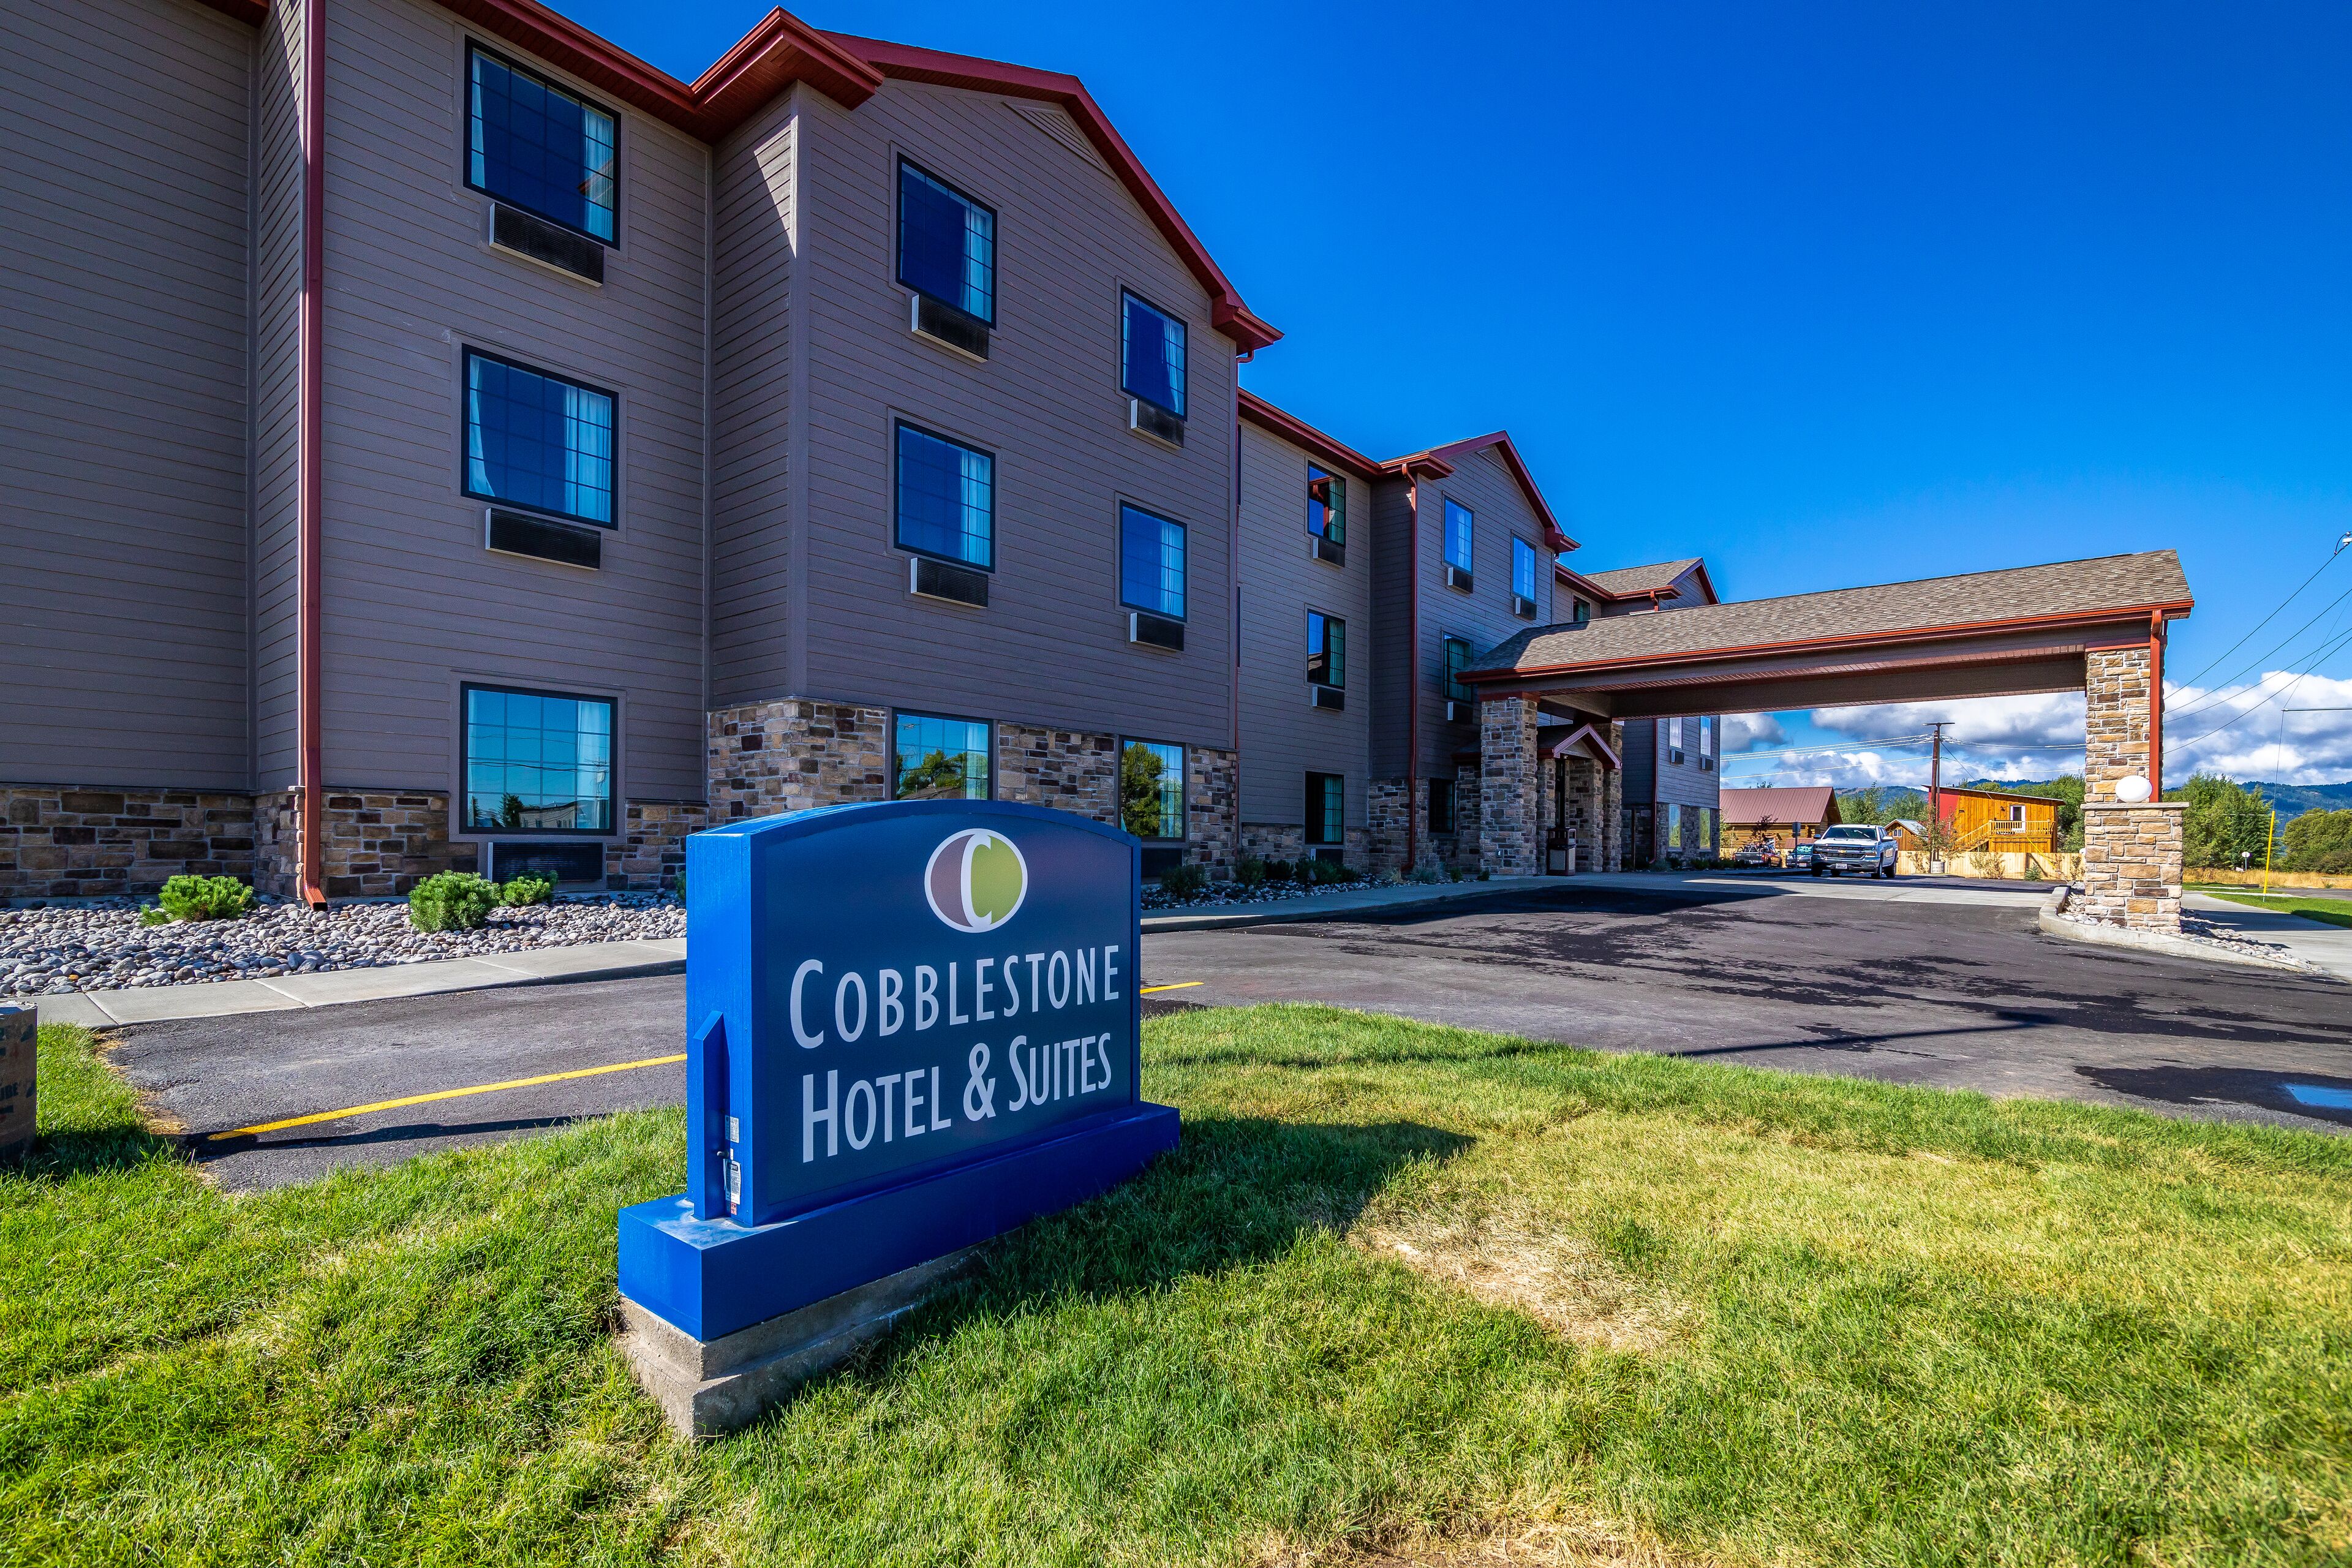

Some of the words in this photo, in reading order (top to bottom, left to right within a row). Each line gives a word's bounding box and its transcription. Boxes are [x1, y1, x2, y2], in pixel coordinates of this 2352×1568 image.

[790, 944, 1120, 1049] COBBLESTONE
[803, 1066, 951, 1163] HOTEL
[963, 1042, 997, 1121] &
[1009, 1033, 1112, 1112] SUITES
